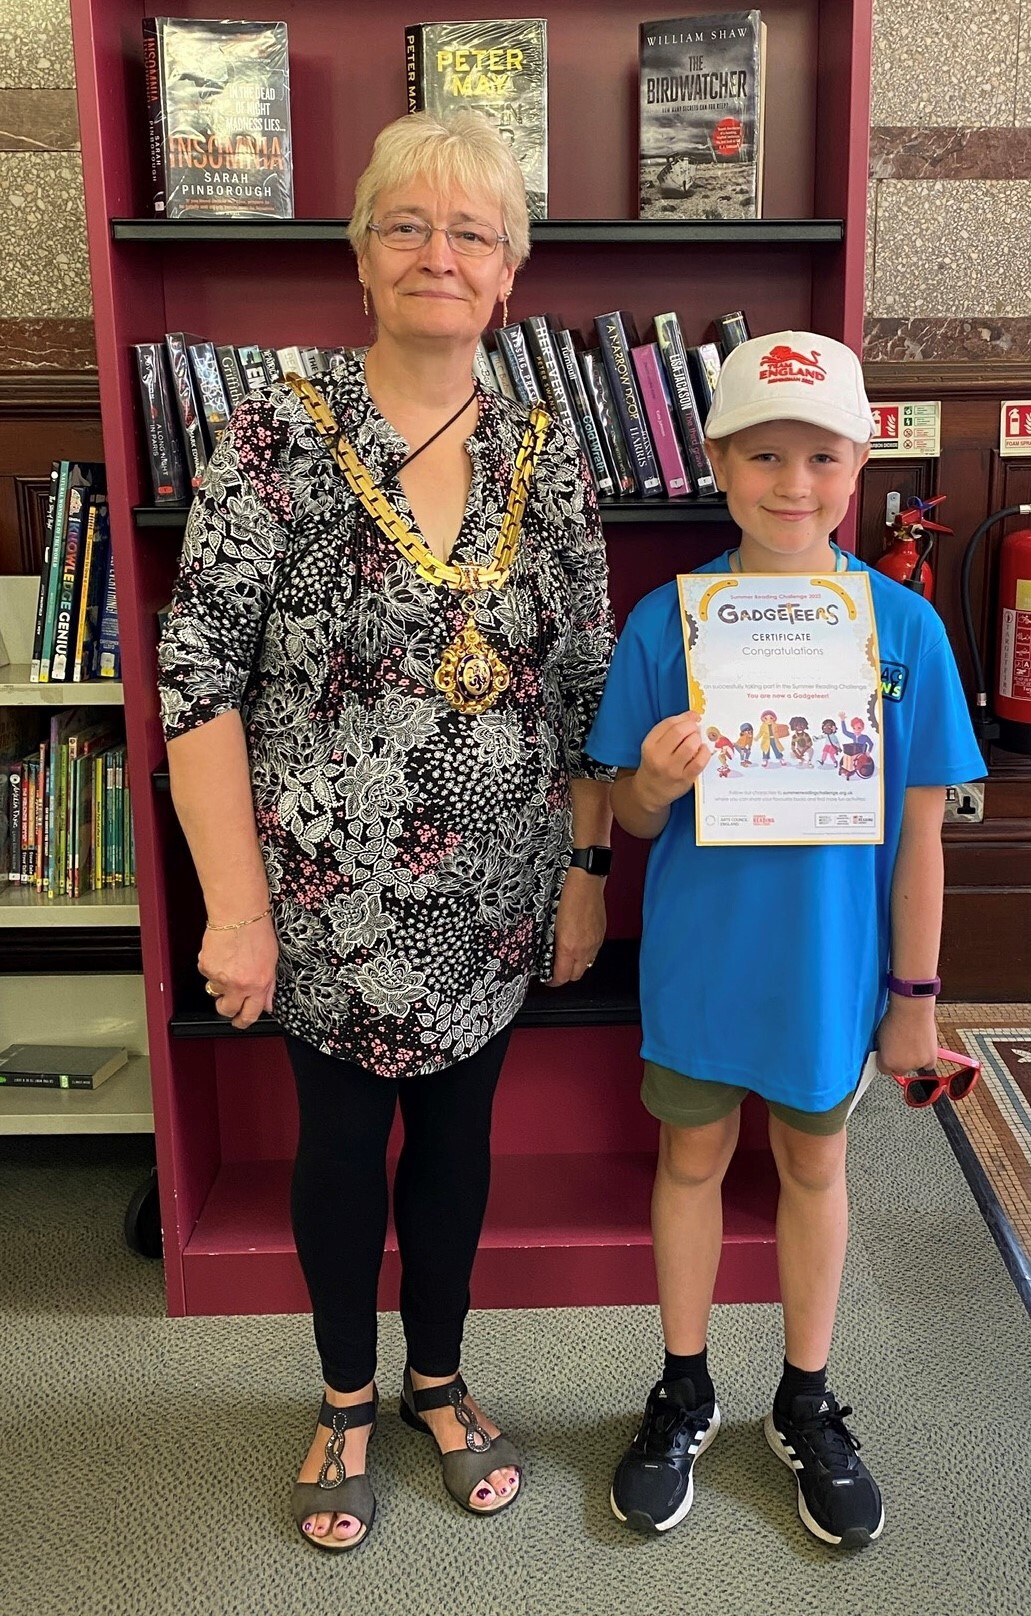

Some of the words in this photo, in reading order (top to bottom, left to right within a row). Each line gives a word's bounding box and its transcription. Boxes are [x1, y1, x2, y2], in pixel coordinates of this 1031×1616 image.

[647, 32, 703, 46] WILLIAM
[711, 28, 747, 40] SHAW
[406, 35, 416, 81] PETER
[436, 48, 524, 72] PETER
[689, 56, 704, 72] THE
[144, 38, 157, 102] INSOMNIA
[239, 86, 255, 99] THE
[256, 88, 275, 100] DEAD
[452, 74, 511, 96] MAY
[647, 70, 747, 104] BIRDWATCHER
[248, 103, 270, 115] NIGHT
[407, 86, 416, 114] MAY
[226, 117, 263, 131] MADNESS
[169, 135, 284, 169] INSOMNIA
[204, 173, 248, 183] SARAH
[182, 185, 271, 196] PINBOROUGH
[606, 324, 617, 333] A
[308, 356, 317, 372] THE
[561, 346, 577, 380] Turnbull
[609, 334, 631, 386] NARROW
[668, 354, 682, 372] LISA
[221, 356, 244, 407] Griffiths
[536, 327, 553, 358] HER
[546, 360, 567, 406] EVERY
[560, 409, 575, 436] FEA
[760, 368, 825, 380] ENGLAND
[523, 374, 537, 403] PRESU
[535, 356, 547, 380] PETER
[543, 382, 559, 421] SWANSO
[673, 371, 692, 411] JACKSON
[622, 388, 639, 420] DOOR
[149, 424, 155, 433] IN
[685, 412, 694, 426] The
[149, 434, 160, 457] PARIS
[155, 430, 166, 452] LONG
[188, 430, 197, 448] MARK
[582, 415, 597, 442] Cold
[590, 441, 606, 473] Wrath
[629, 426, 648, 468] HARRIS
[688, 428, 699, 444] third
[158, 452, 171, 477] NIGHT
[191, 448, 203, 479] EDWARDS
[58, 472, 67, 497] NATURAL
[55, 499, 64, 527] WONDERS
[52, 547, 60, 568] WORLD
[60, 522, 80, 610] KNOWLEDGE
[718, 603, 839, 625] GADGETEERS
[752, 633, 811, 641] CERTIFICATE
[742, 647, 824, 657] Congratulations
